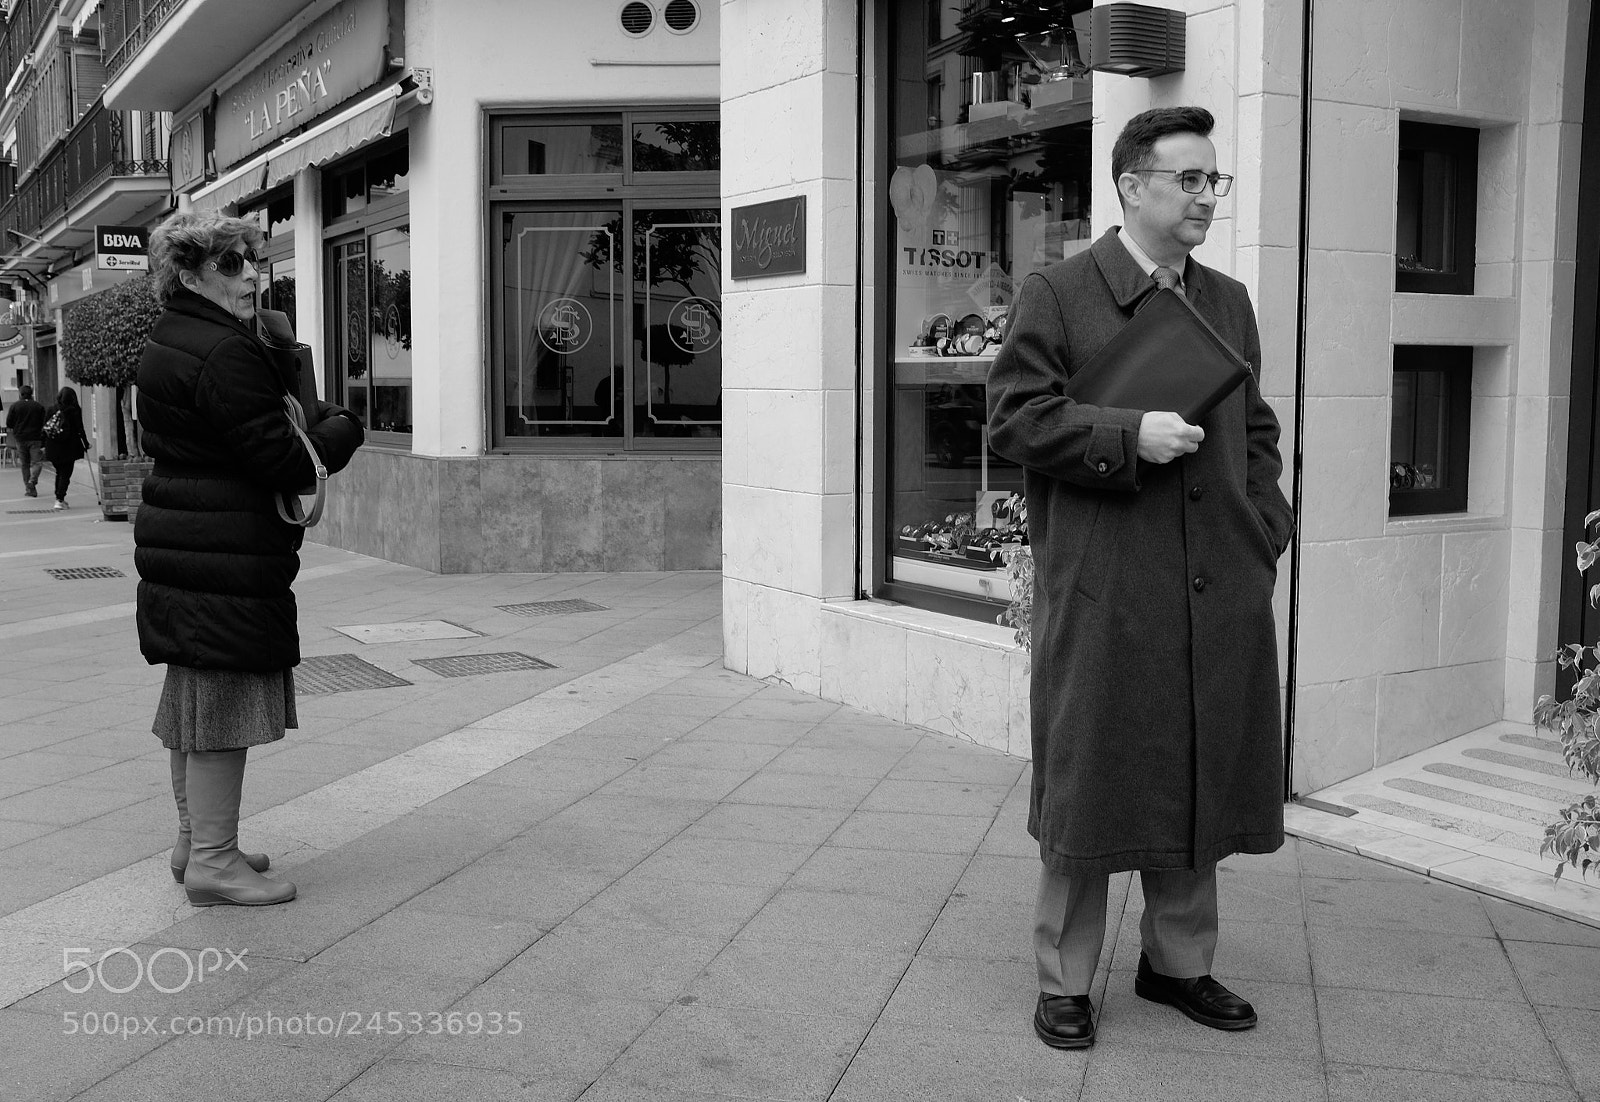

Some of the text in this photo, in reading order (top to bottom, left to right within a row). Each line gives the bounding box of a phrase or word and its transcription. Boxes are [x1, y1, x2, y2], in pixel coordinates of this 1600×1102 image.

[103, 233, 142, 248] BBVA
[736, 202, 799, 270] Miguel
[903, 247, 986, 269] TISSOT
